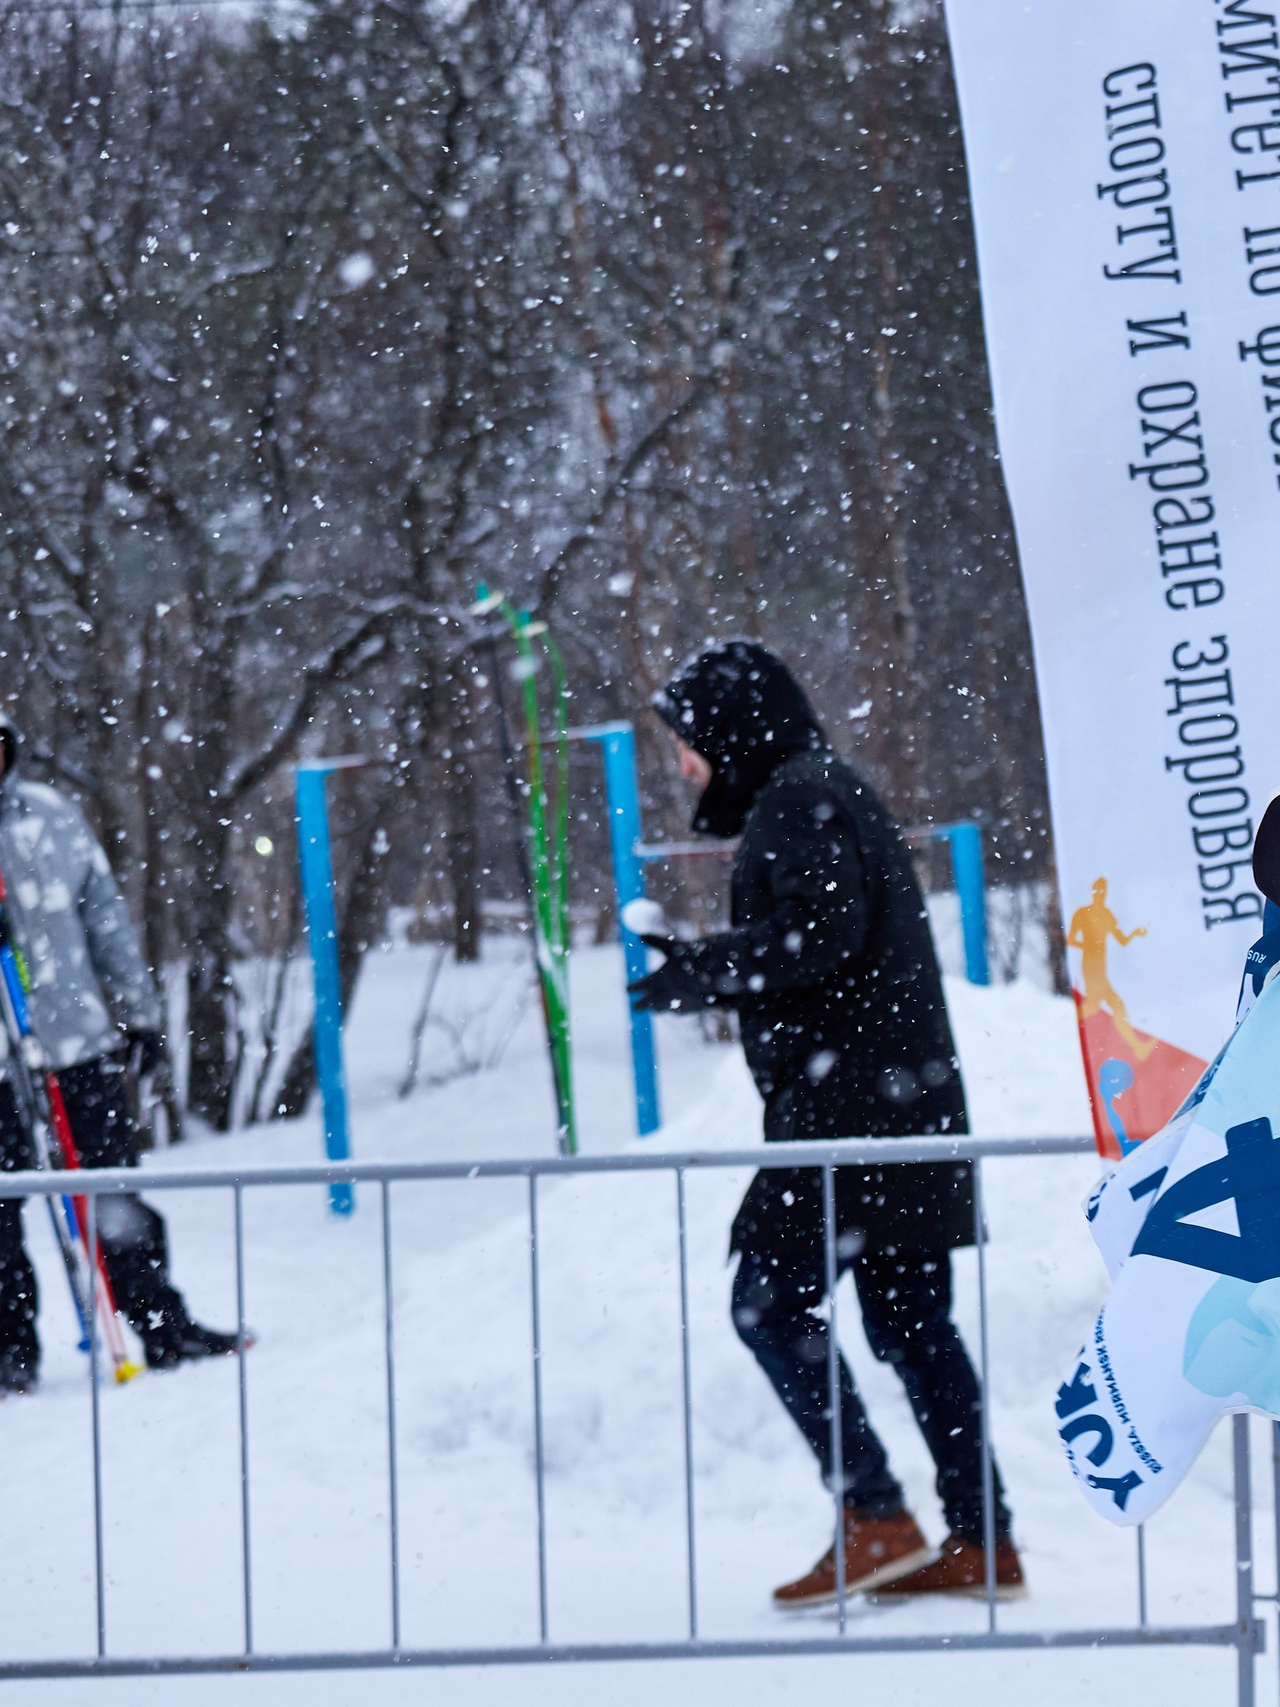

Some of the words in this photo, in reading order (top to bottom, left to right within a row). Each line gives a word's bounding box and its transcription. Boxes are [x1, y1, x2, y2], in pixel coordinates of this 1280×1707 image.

[1097, 61, 1183, 285] спорту
[1126, 310, 1192, 358] и
[1128, 380, 1226, 612] охране
[1164, 634, 1264, 932] здоровья
[1055, 1345, 1146, 1512] YUK
